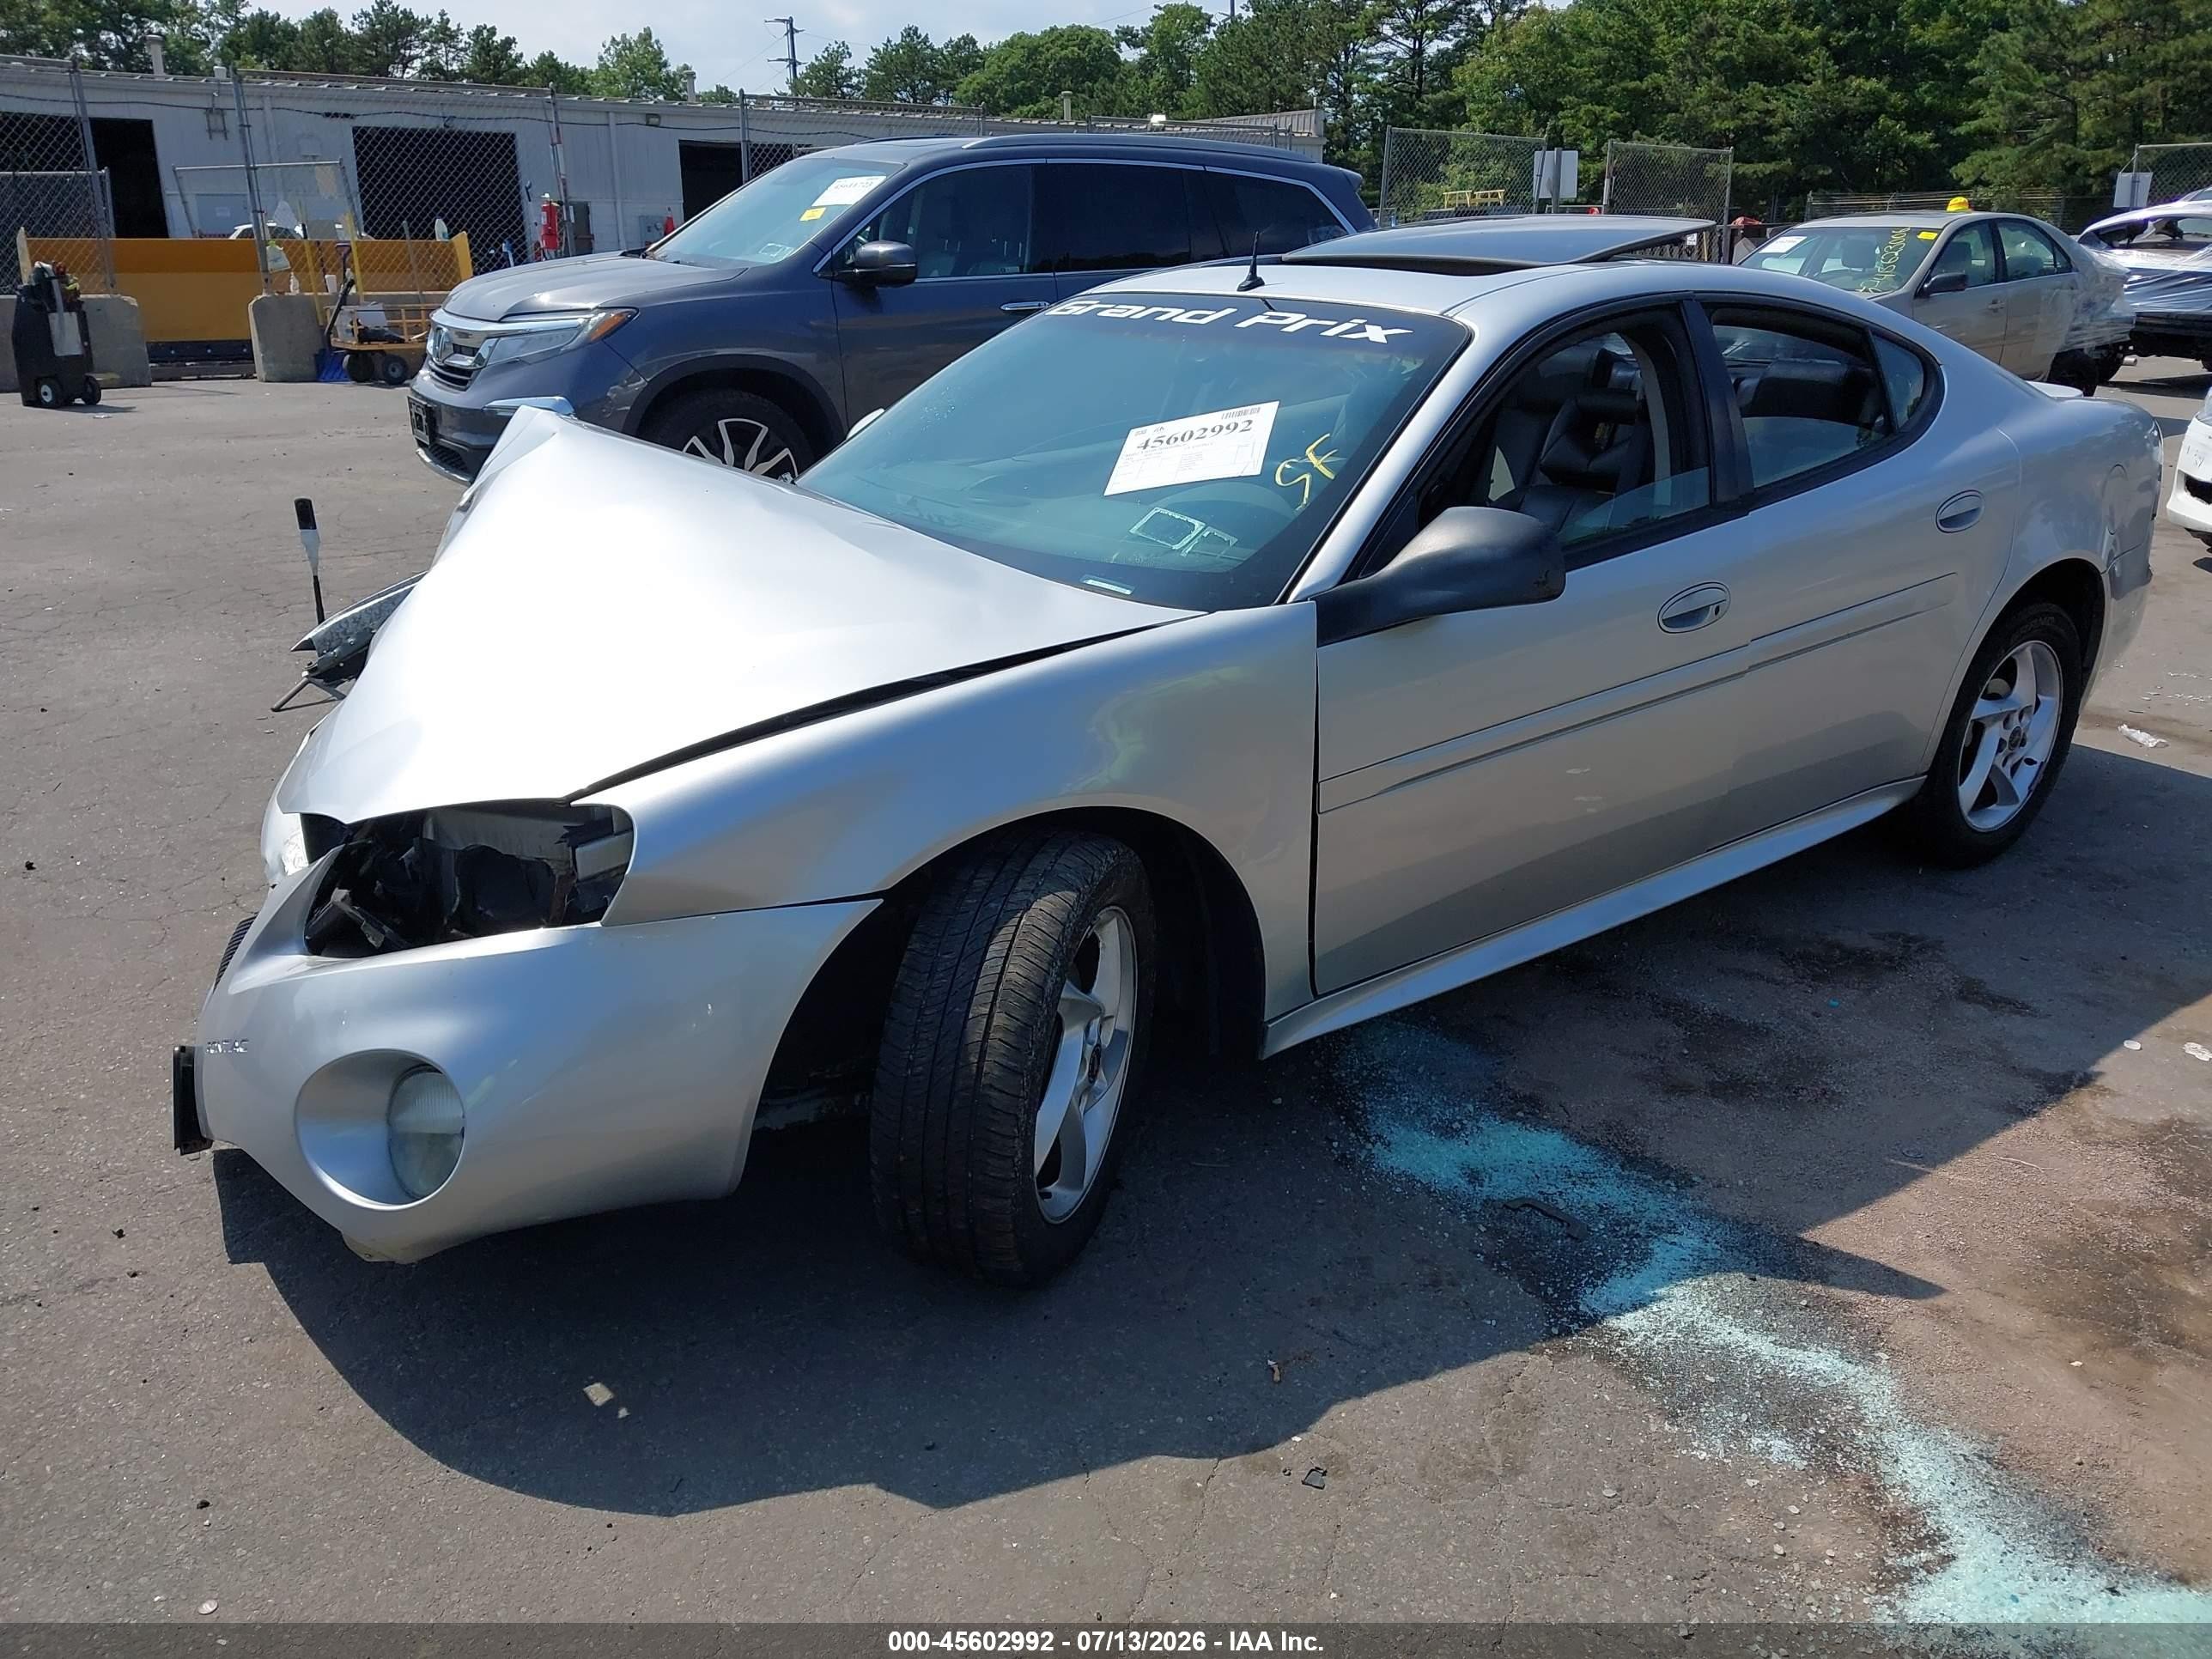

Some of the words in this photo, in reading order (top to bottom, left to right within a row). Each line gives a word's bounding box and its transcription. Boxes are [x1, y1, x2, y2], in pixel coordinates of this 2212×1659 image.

[1044, 300, 1237, 325] Grand
[1233, 310, 1413, 344] Prix
[1136, 418, 1255, 451] 45602992
